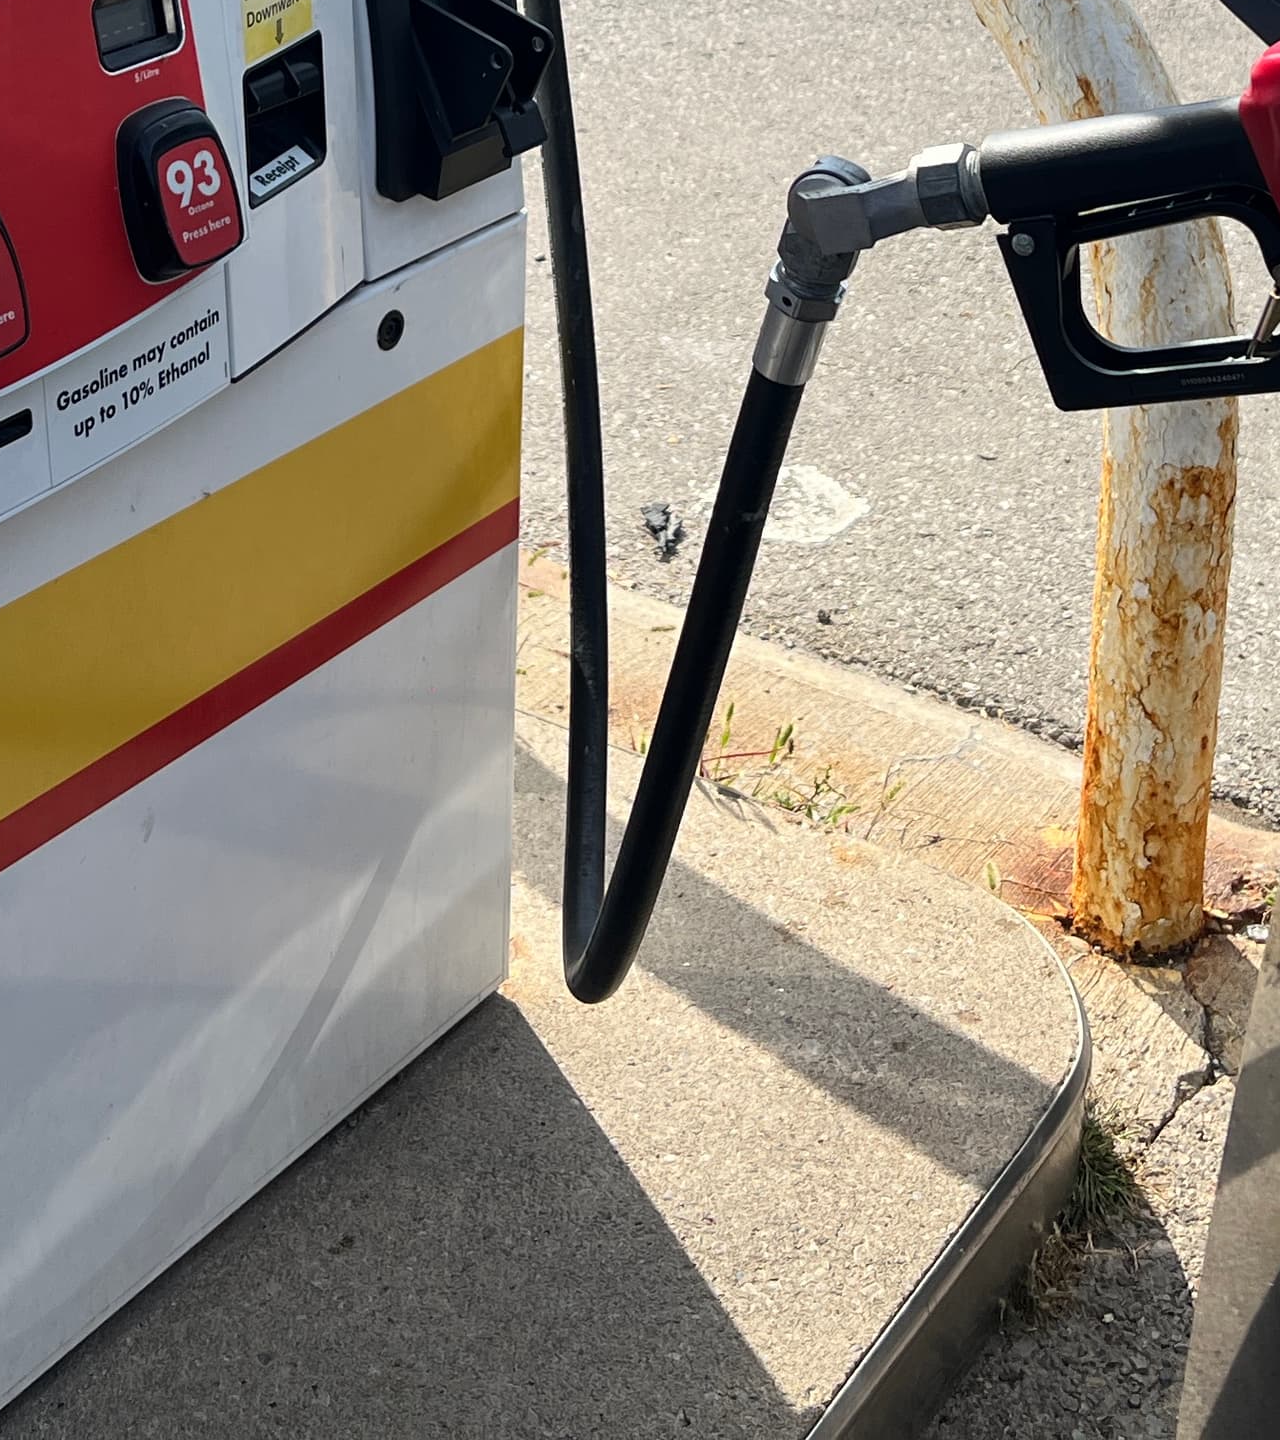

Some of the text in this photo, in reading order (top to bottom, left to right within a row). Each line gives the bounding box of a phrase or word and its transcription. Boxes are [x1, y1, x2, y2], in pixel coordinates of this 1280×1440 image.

[166, 150, 221, 209] 93
[254, 154, 301, 187] Receipt
[182, 215, 232, 244] Press here
[188, 200, 215, 216] Octane
[56, 309, 220, 412] Gasoline may contain
[74, 341, 210, 438] up to 10% Ethanol
